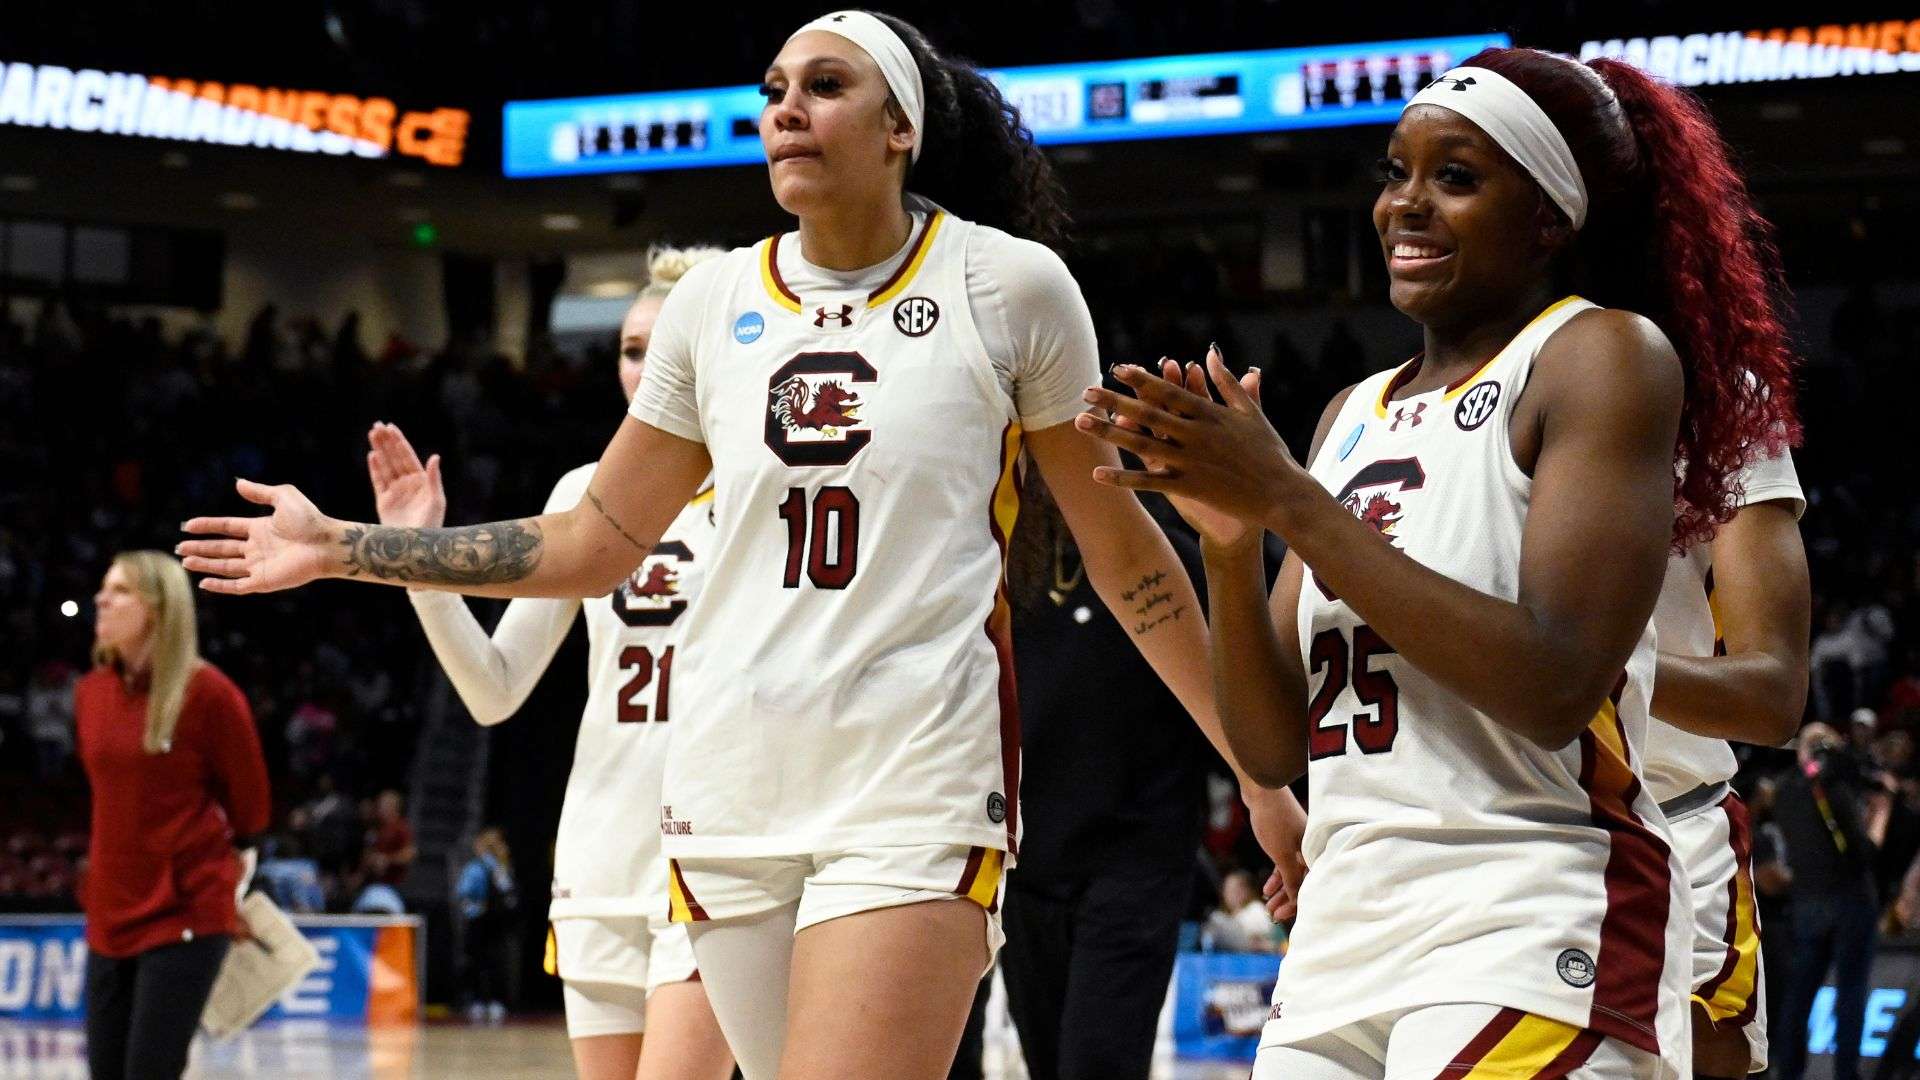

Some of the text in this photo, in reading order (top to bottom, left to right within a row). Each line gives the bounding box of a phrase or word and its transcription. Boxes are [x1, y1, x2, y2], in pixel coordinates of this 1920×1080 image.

[897, 298, 937, 334] SEC
[1457, 383, 1499, 427] SEC
[778, 485, 860, 590] 10
[617, 644, 675, 723] 21
[1308, 624, 1399, 761] 25
